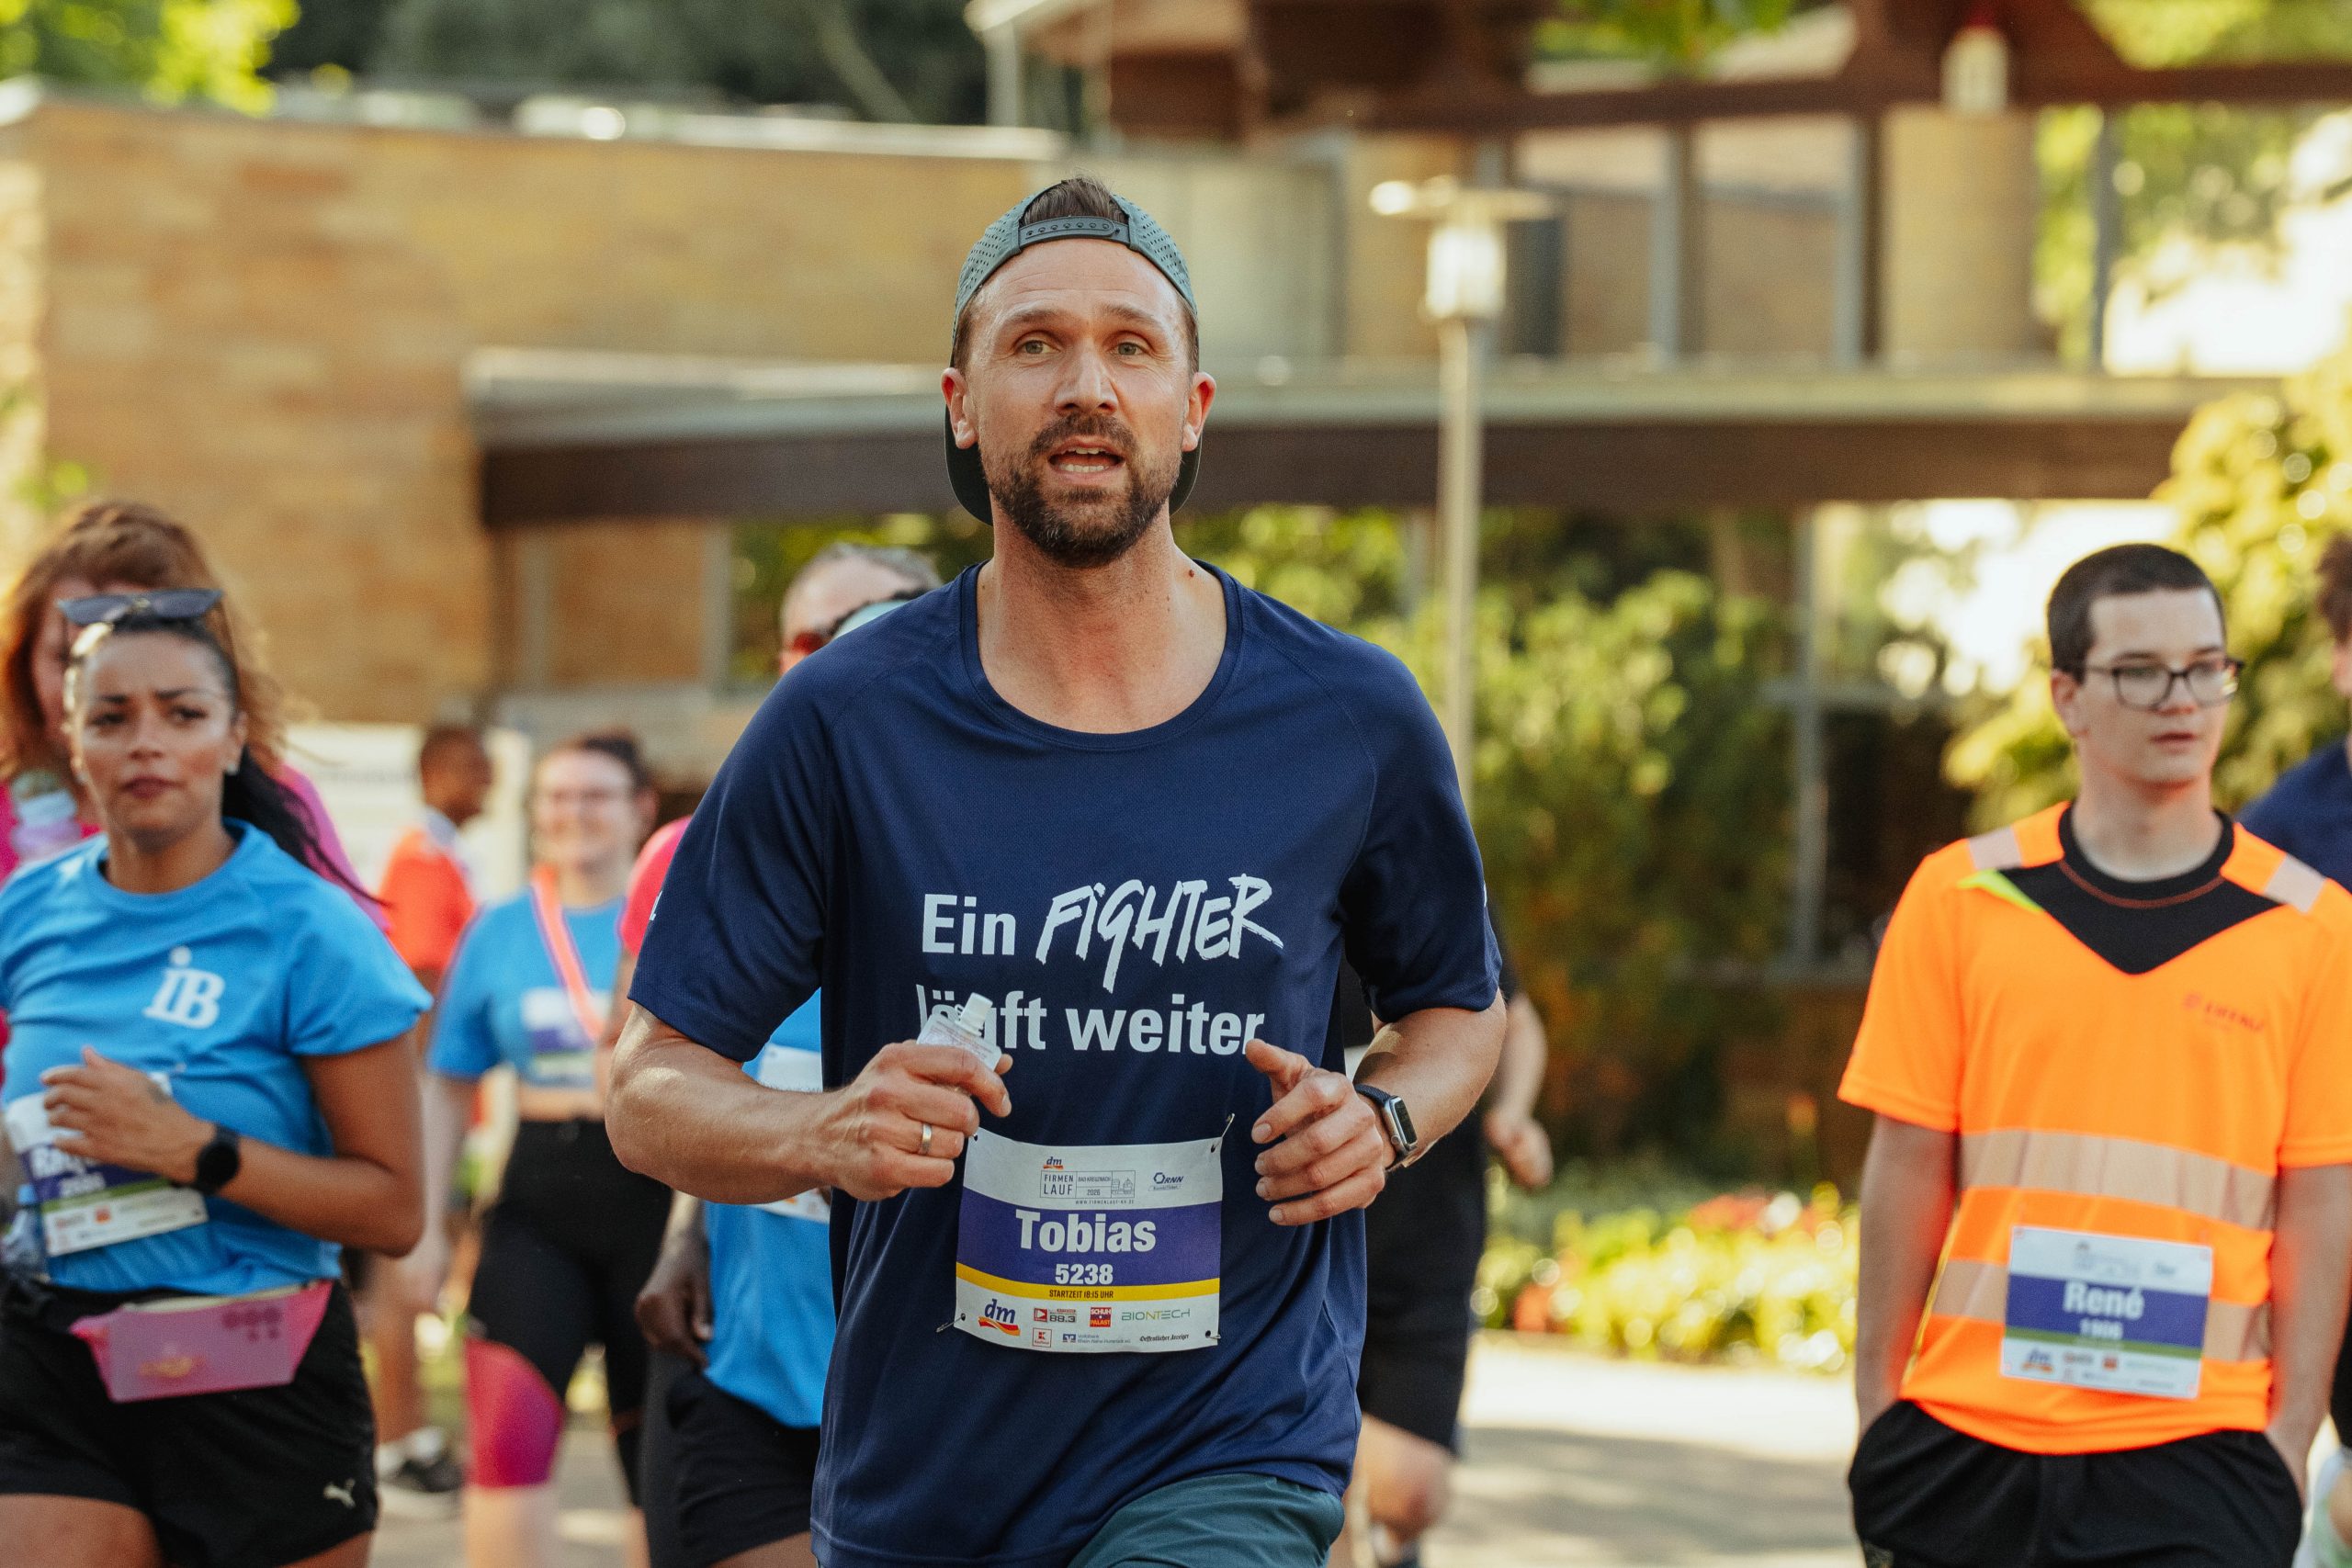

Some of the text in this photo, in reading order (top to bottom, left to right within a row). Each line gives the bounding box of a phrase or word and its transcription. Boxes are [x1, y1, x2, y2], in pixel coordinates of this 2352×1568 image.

[922, 894, 1016, 955] Ein
[1066, 994, 1265, 1055] weiter
[1044, 1184, 1073, 1195] LAUF
[1015, 1209, 1156, 1253] Tobias
[1055, 1263, 1114, 1285] 5238
[1049, 1290, 1082, 1298] STARTZEIT
[2063, 1280, 2144, 1320] René
[984, 1298, 1016, 1324] dm
[1049, 1314, 1076, 1323] 88.3
